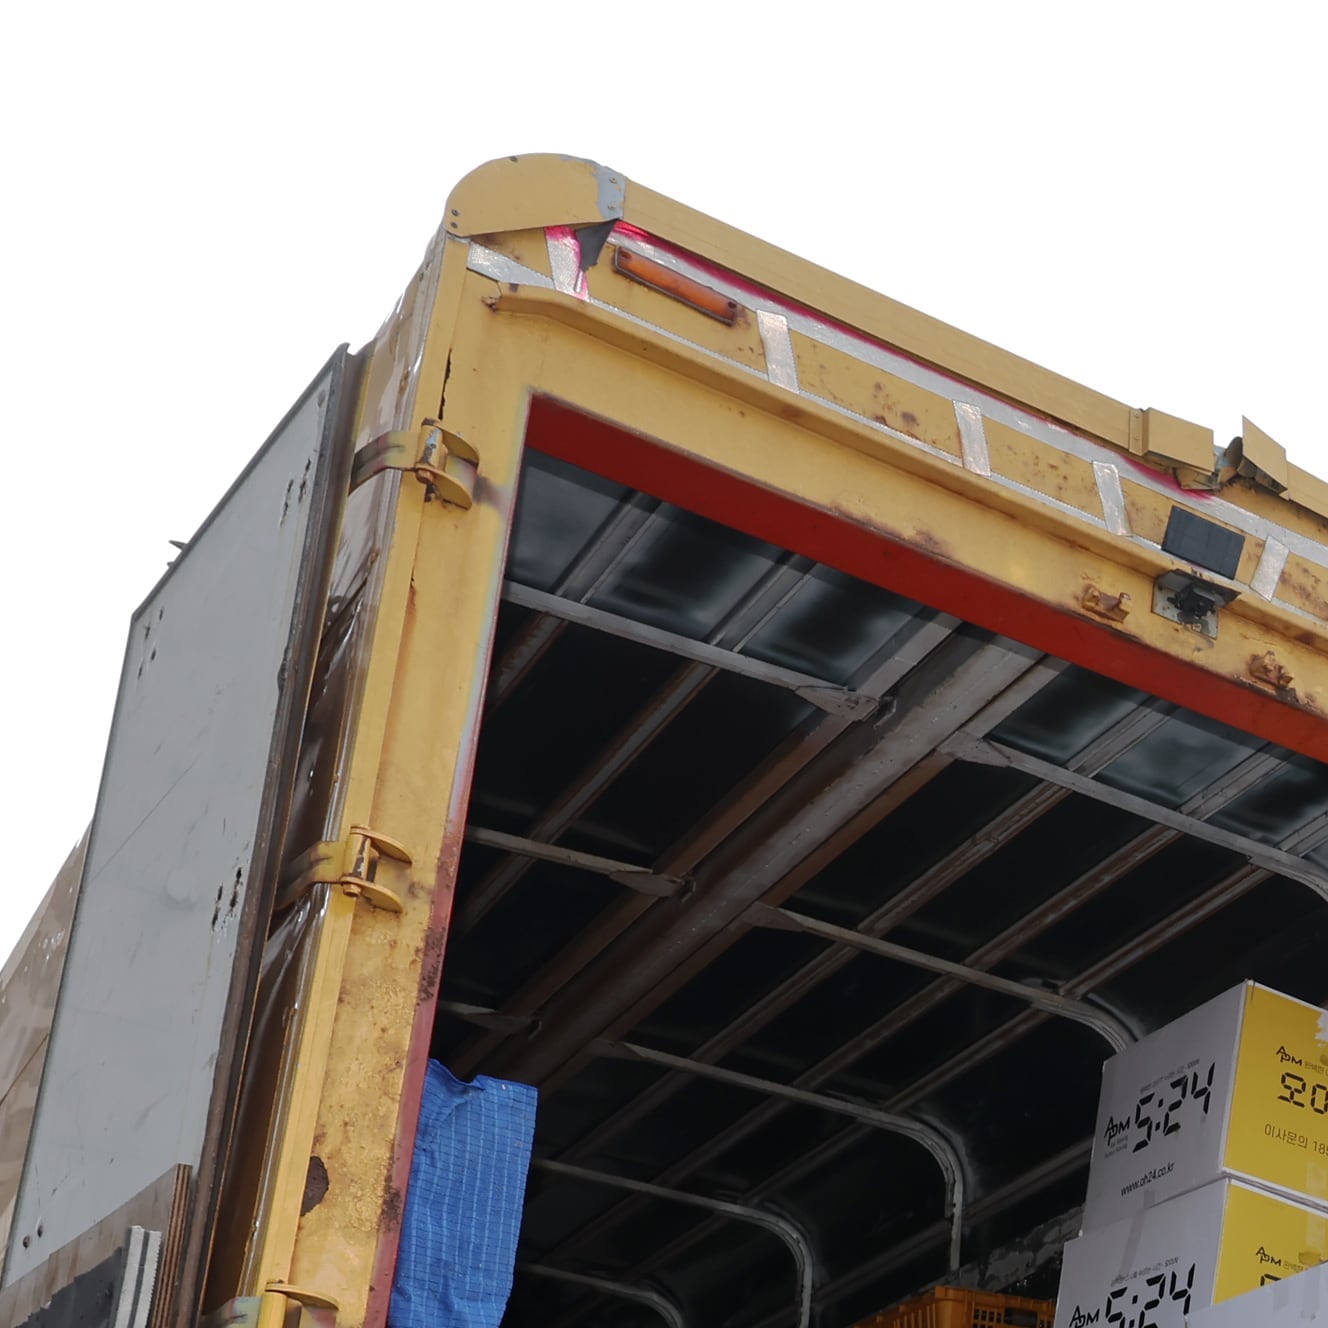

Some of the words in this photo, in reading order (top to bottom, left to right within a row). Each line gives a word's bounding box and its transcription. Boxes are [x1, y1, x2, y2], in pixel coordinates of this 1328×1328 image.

[1133, 1062, 1215, 1153] 5:24
[1264, 1123, 1308, 1149] 이사문의
[1121, 1162, 1175, 1196] www.oh24.co.kr
